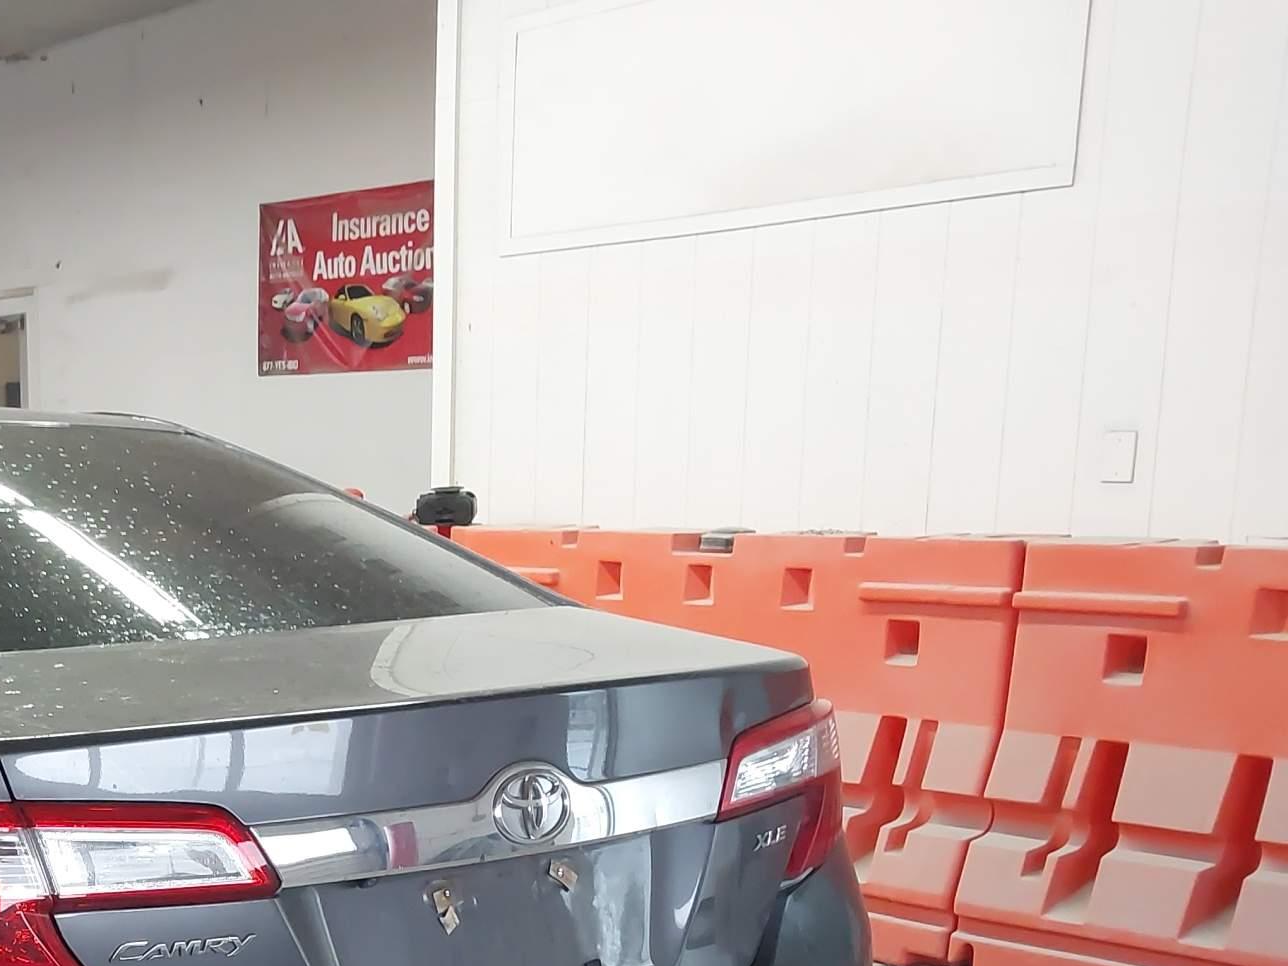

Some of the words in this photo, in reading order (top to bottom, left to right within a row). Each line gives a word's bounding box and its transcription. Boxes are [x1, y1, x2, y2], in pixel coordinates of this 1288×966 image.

[332, 208, 430, 242] Insurance
[313, 251, 357, 281] Auto
[753, 825, 787, 852] XLE
[109, 934, 257, 962] CAMRY
